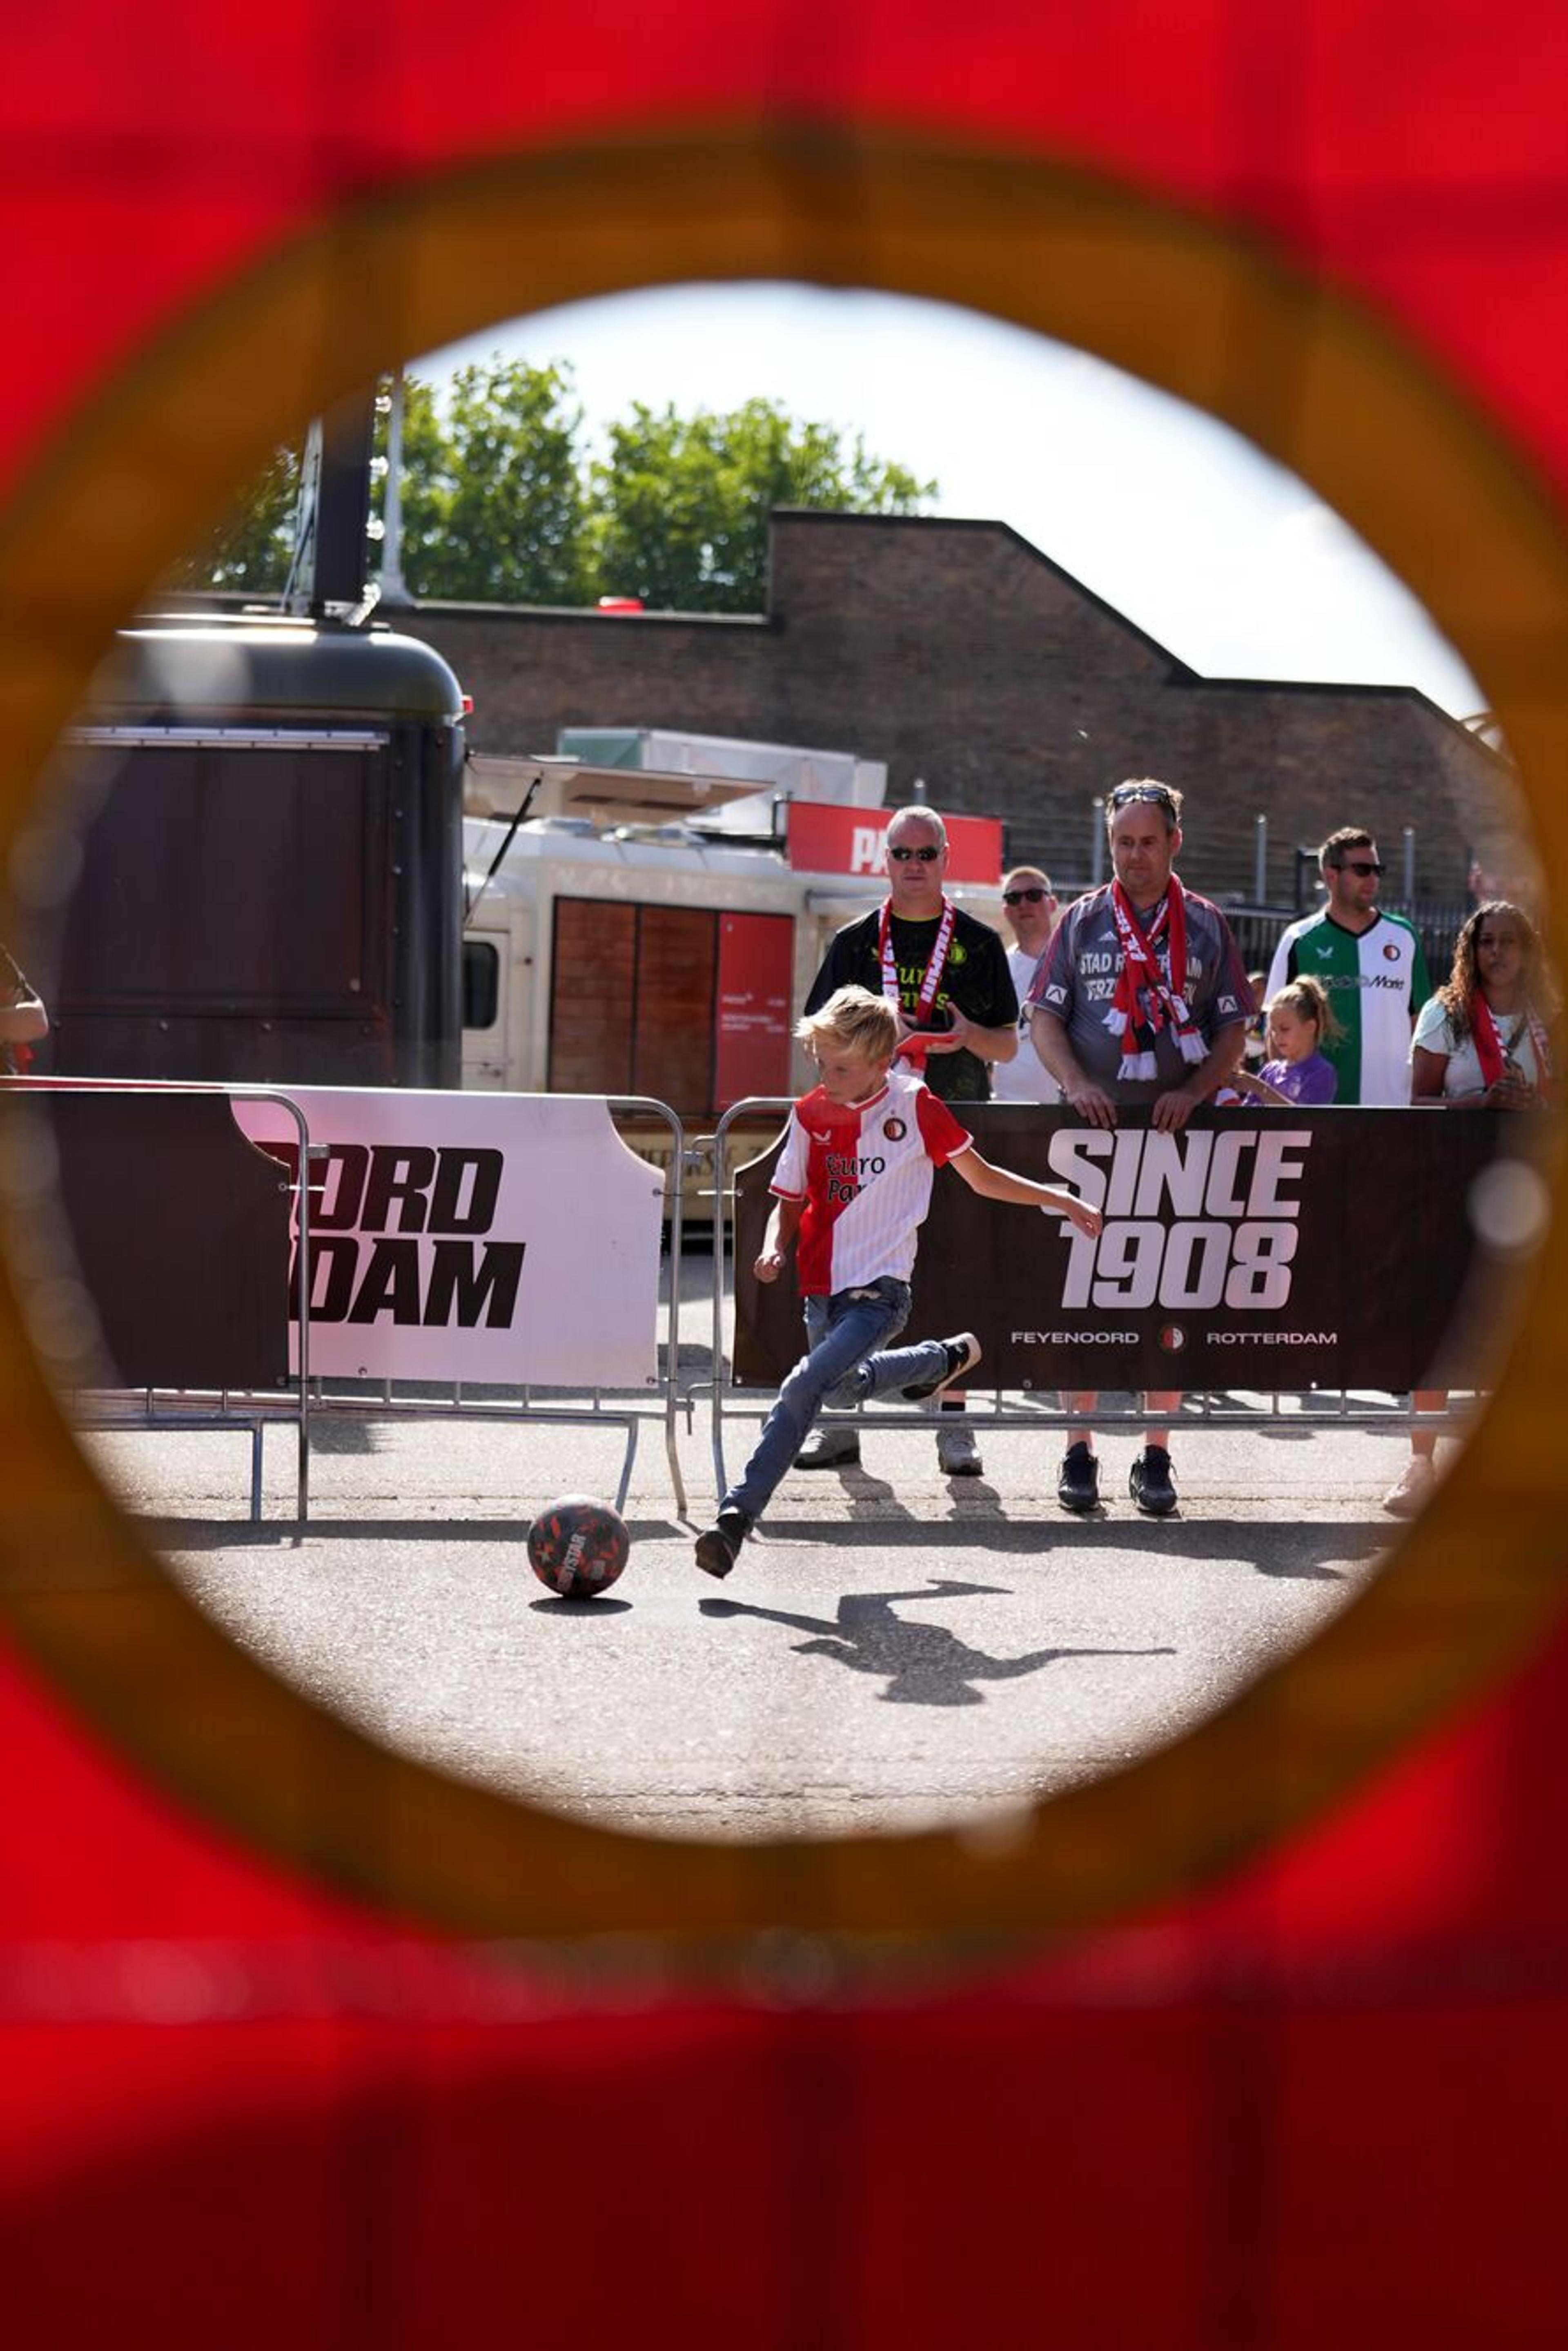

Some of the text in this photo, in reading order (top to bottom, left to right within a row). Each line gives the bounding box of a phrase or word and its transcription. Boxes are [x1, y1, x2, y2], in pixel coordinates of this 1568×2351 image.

[826, 1155, 886, 1176] Euro
[1040, 1129, 1313, 1216] SINCE
[827, 1178, 870, 1202] Par
[1059, 1221, 1299, 1309] 1908
[1011, 1331, 1337, 1345] FEYENOORD ROTTERDAM
